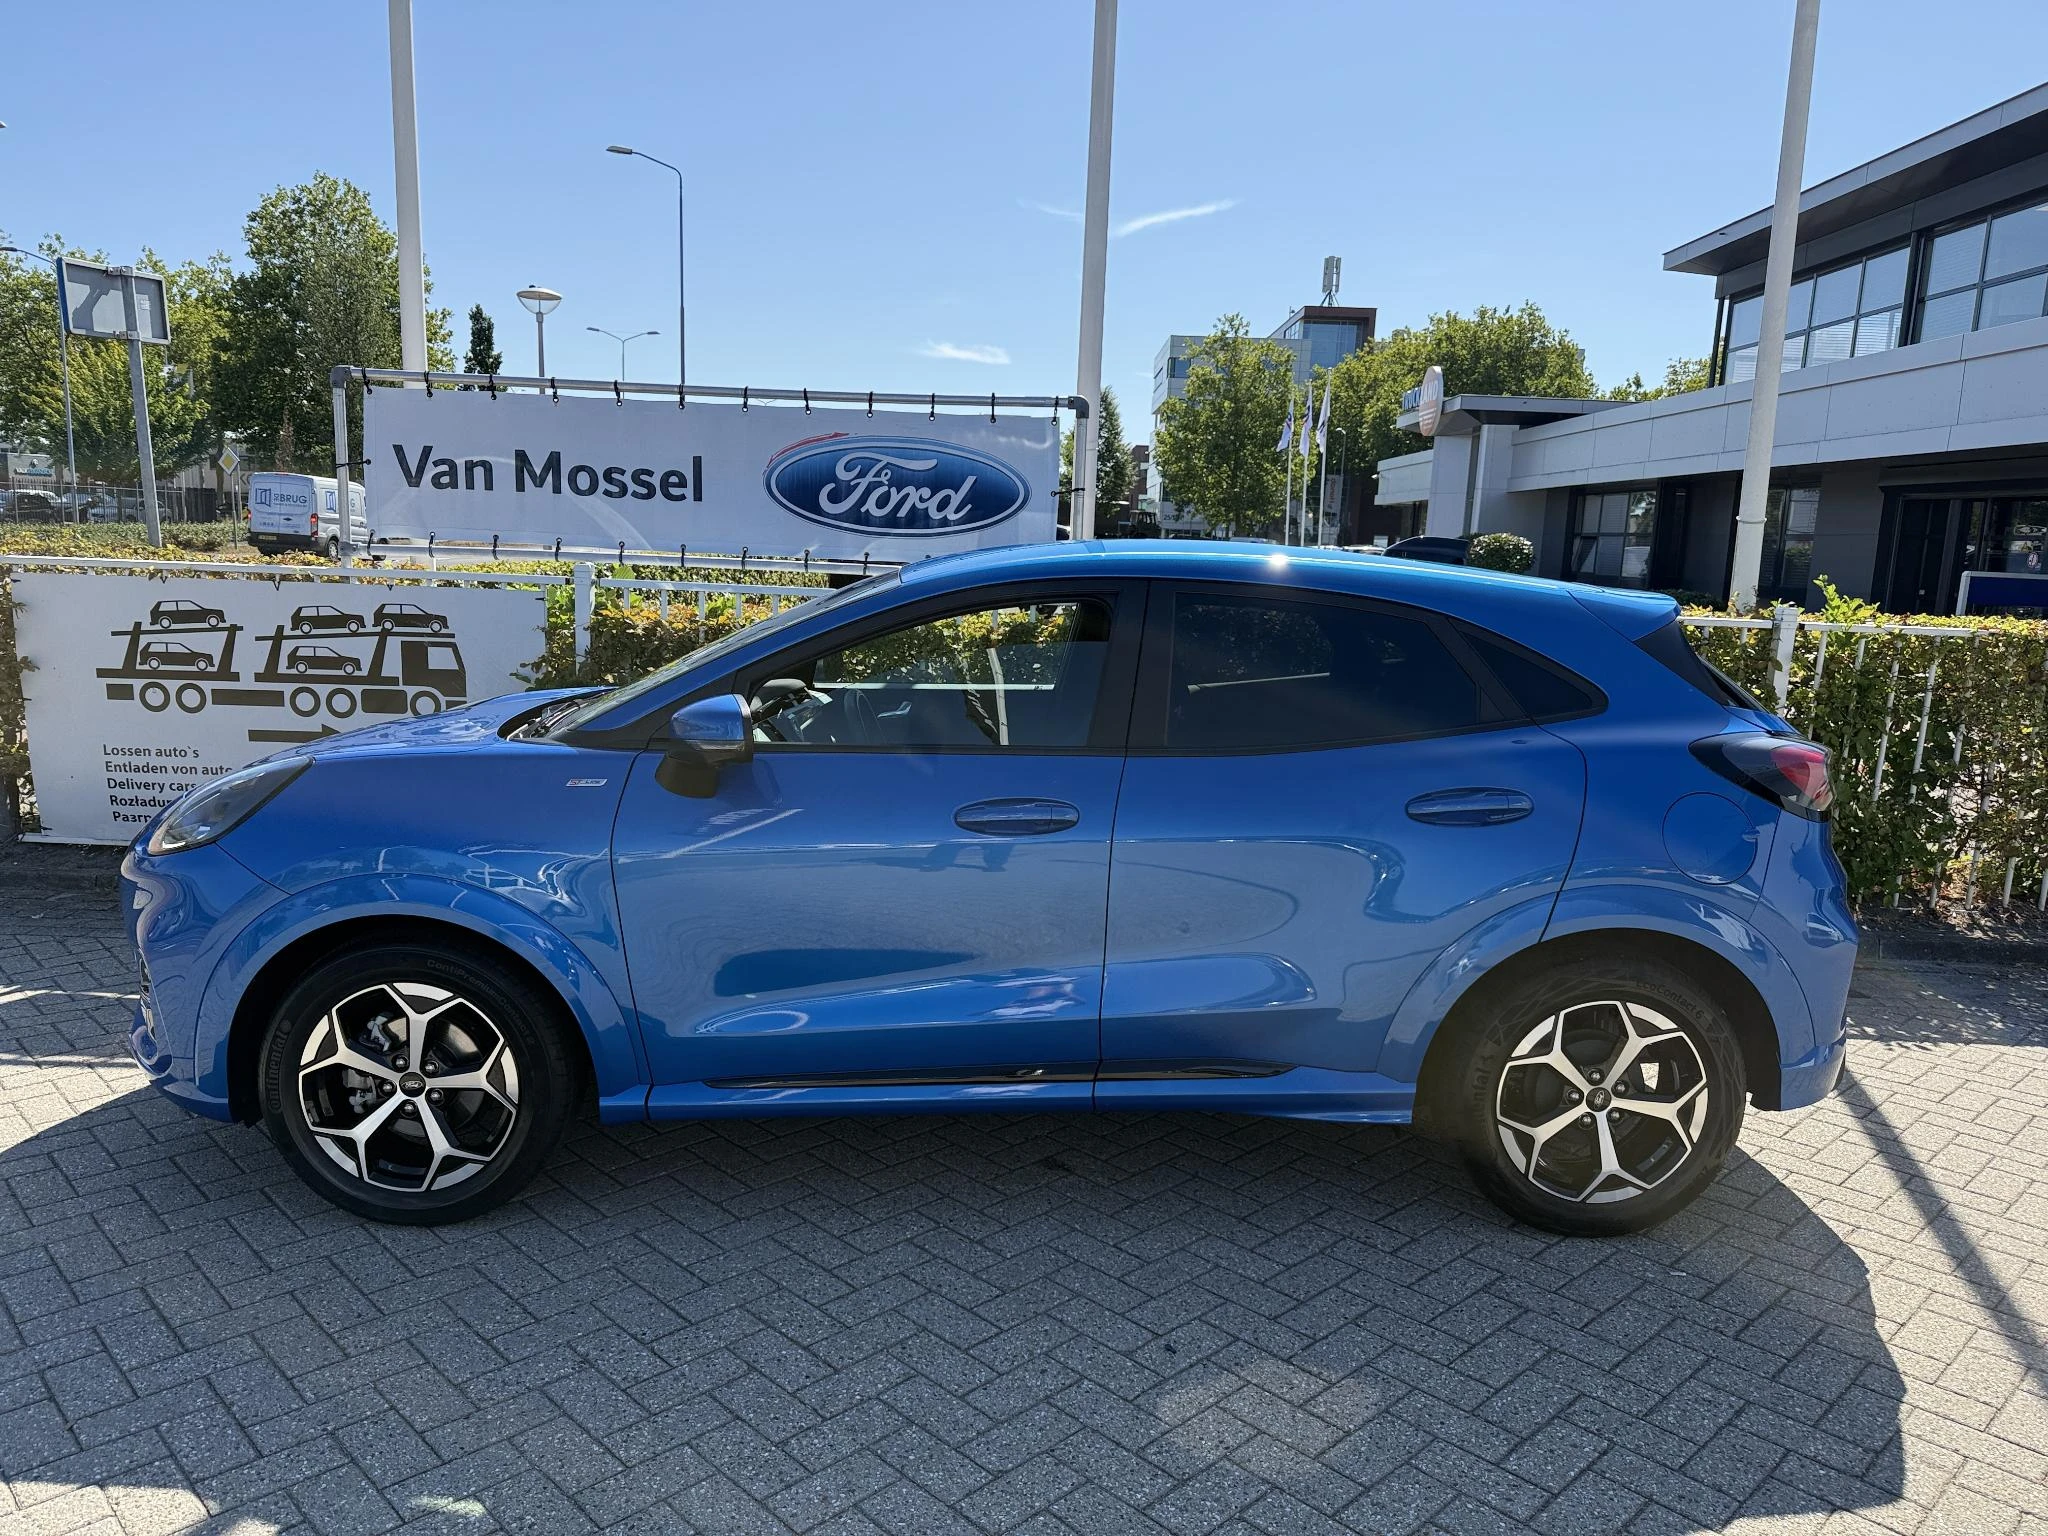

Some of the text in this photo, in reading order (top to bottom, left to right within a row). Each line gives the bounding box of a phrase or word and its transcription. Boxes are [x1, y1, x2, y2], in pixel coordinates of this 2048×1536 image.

[392, 444, 703, 503] Van Mossel
[818, 451, 978, 521] Ford
[280, 494, 307, 504] BRUG
[103, 744, 151, 757] Lossen
[105, 761, 168, 774] Entladen
[171, 765, 198, 775] von
[107, 778, 166, 794] Delivery
[267, 1030, 289, 1114] Continental
